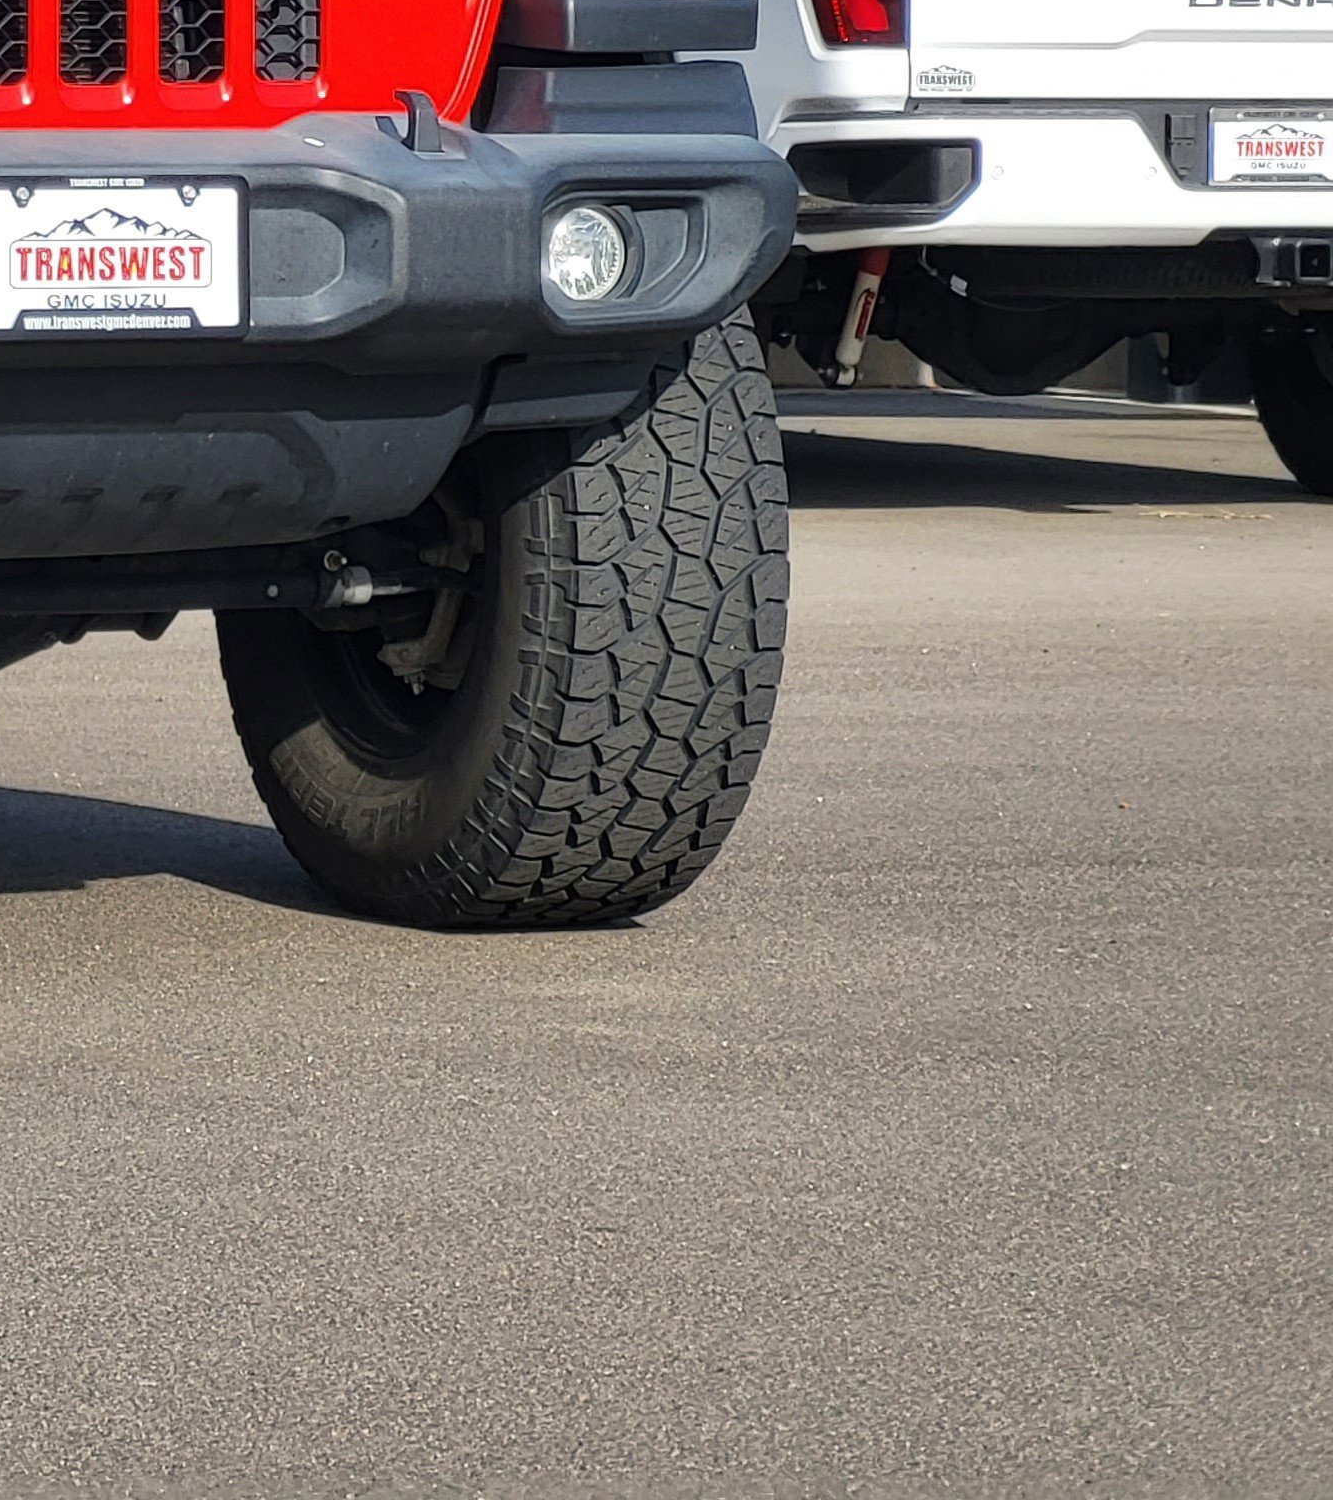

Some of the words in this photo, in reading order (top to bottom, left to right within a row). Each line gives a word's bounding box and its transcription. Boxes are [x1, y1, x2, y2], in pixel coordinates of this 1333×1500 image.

[1236, 141, 1325, 157] TRANSWEST
[15, 246, 205, 281] TRANSWEST
[47, 294, 95, 309] GMC
[104, 293, 166, 309] ISUZU
[24, 314, 192, 331] www.transwestgmcdenver.com
